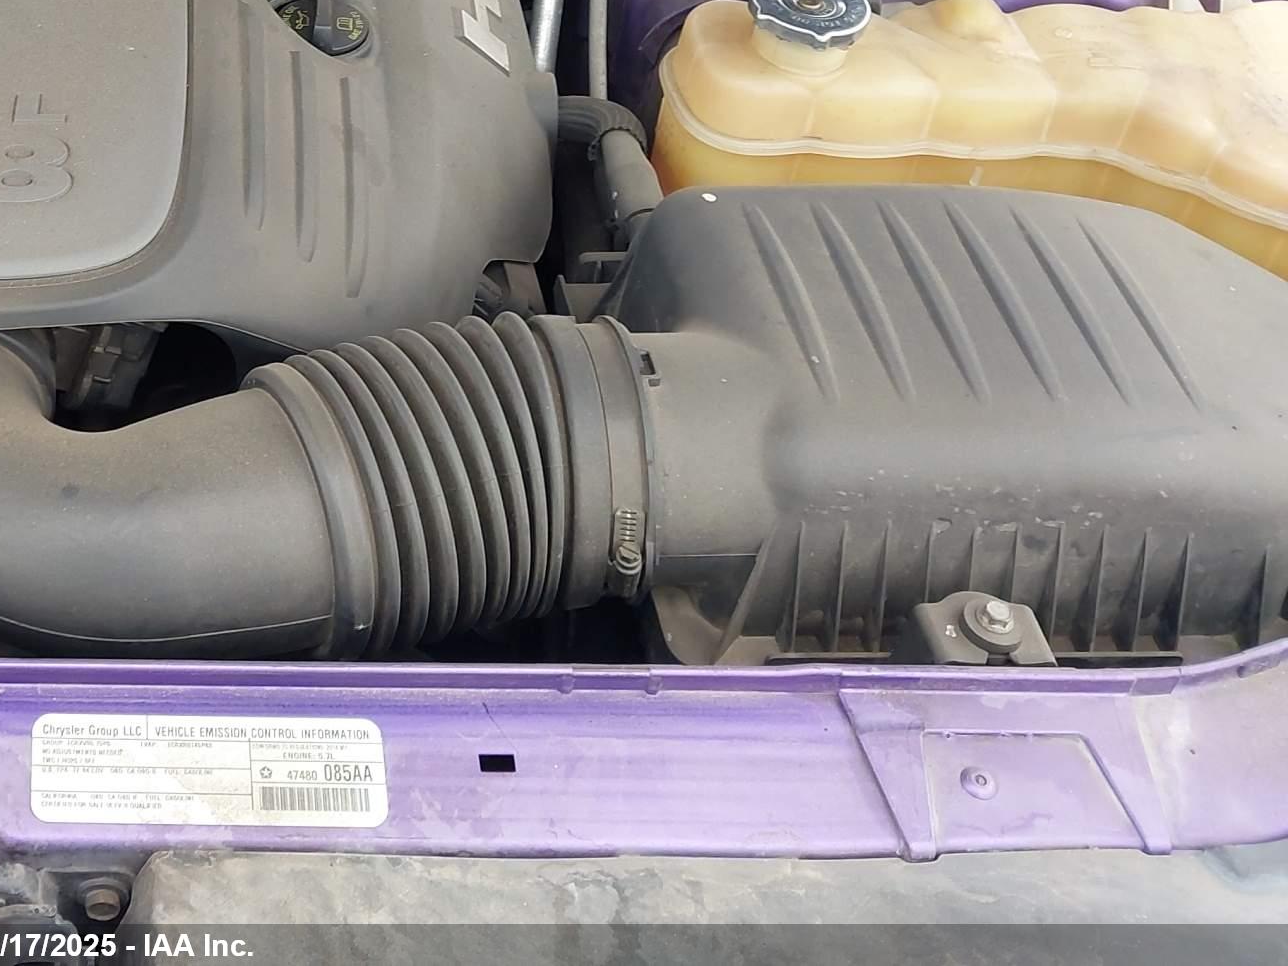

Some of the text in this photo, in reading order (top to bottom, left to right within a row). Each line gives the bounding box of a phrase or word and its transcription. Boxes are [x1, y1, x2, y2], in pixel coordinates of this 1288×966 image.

[42, 723, 143, 737] Chrysler Group LLC
[154, 726, 370, 741] VEHICLE EMISSION CONTROL INFORMATION
[286, 764, 373, 782] 47480 085AA
